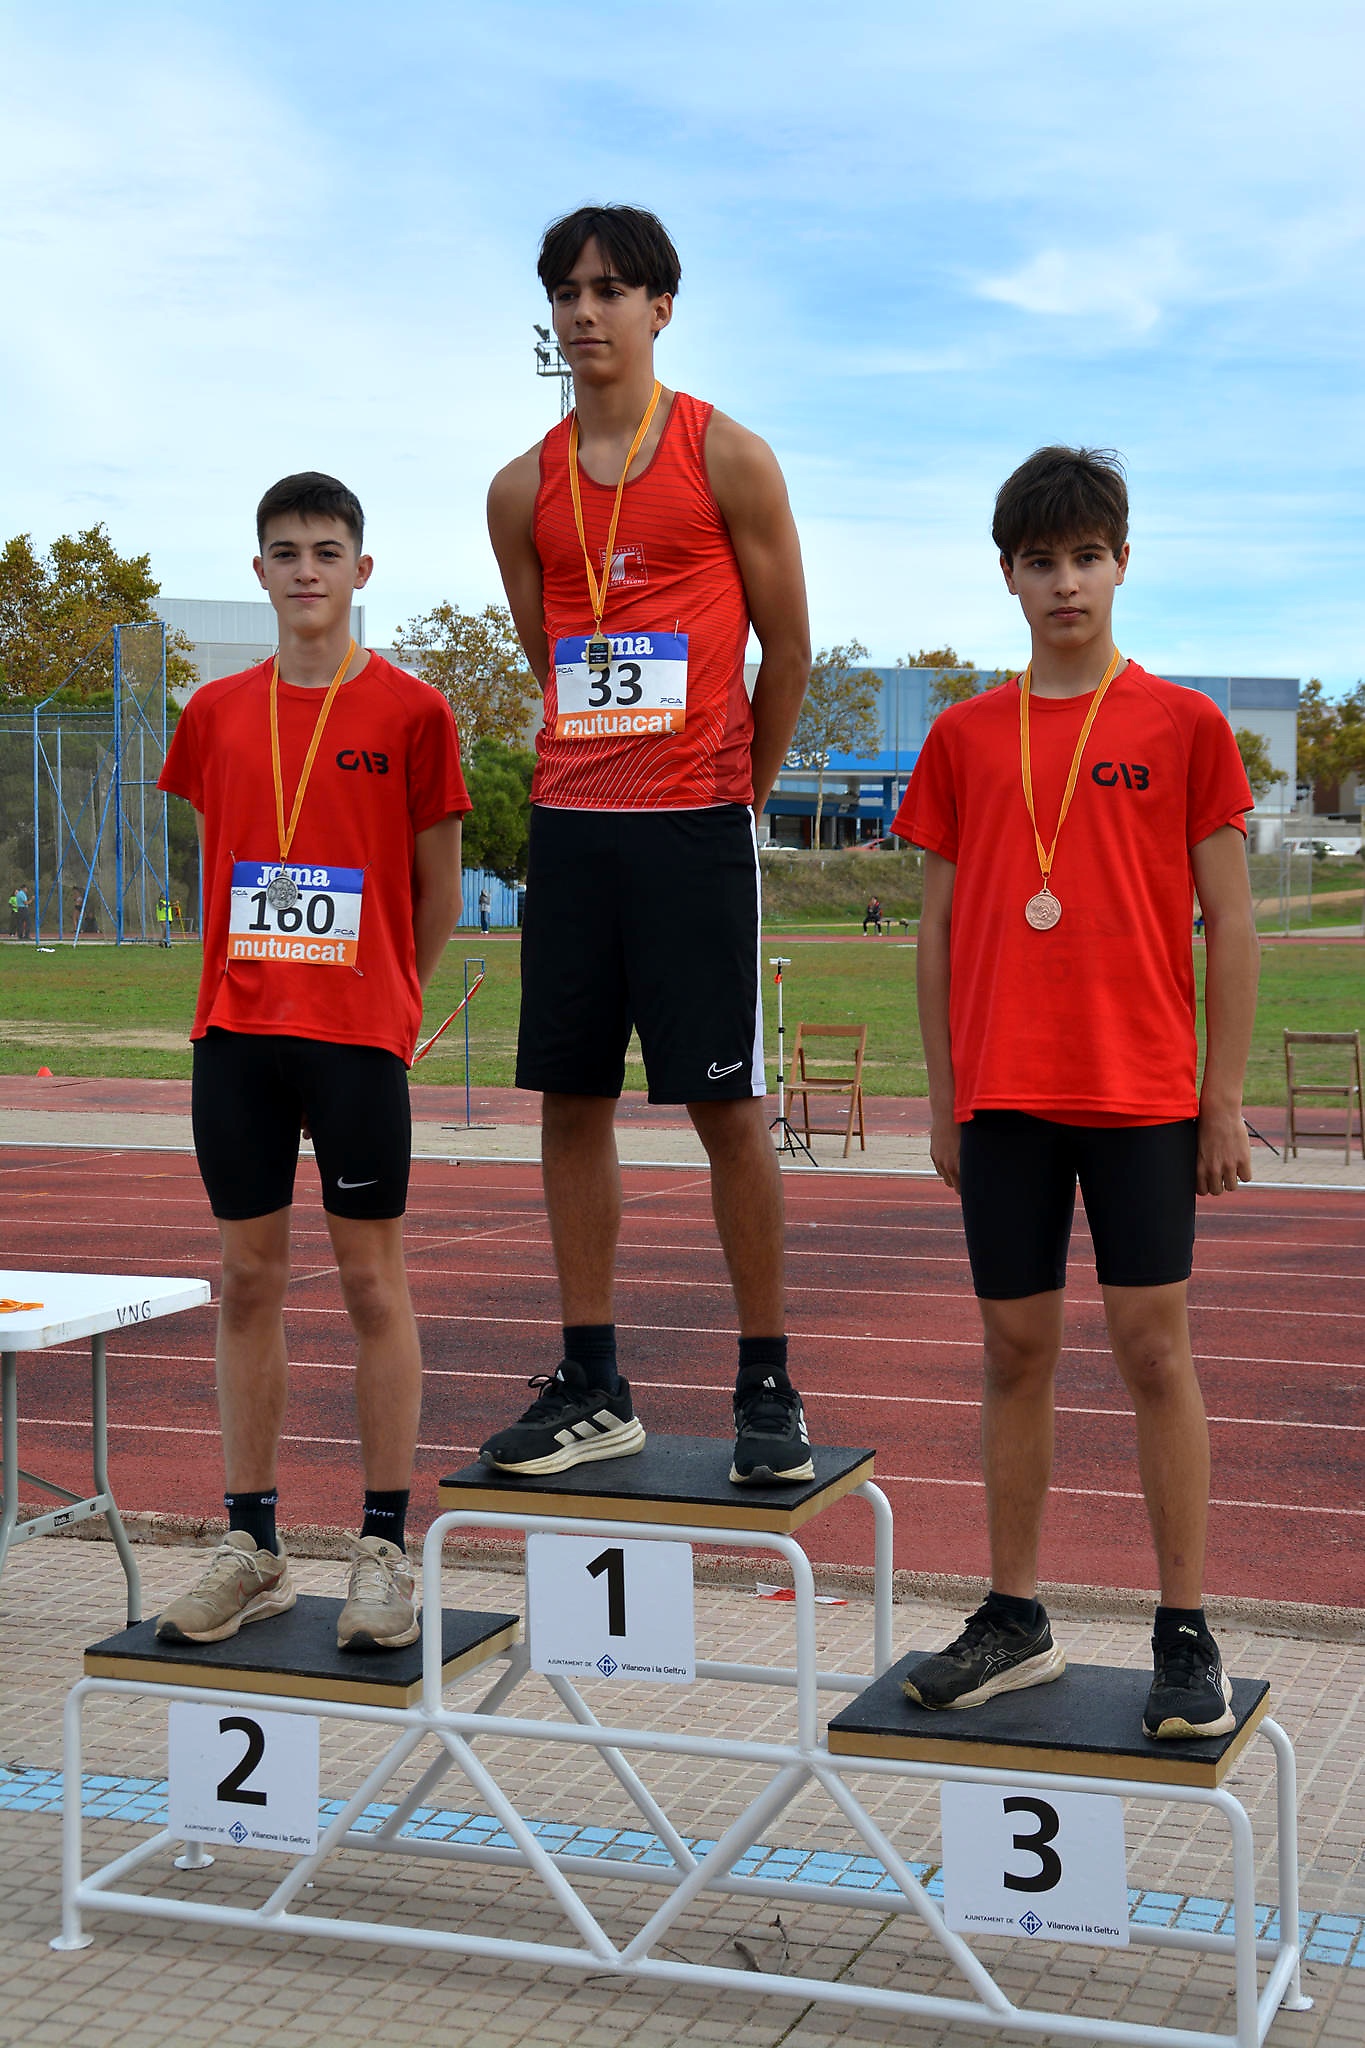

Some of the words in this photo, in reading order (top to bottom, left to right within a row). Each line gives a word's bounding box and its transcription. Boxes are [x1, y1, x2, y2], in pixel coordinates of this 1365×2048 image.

[580, 636, 653, 661] ma
[588, 662, 643, 707] 33
[563, 712, 673, 736] mutuacat
[249, 890, 335, 935] 160
[233, 938, 346, 962] mutuacat
[117, 1300, 151, 1325] VNG
[585, 1547, 627, 1637] 1
[548, 1658, 583, 1667] AJUNTAMENT
[621, 1663, 651, 1673] Vilanova
[655, 1665, 662, 1673] la
[216, 1715, 268, 1807] 2
[251, 1831, 278, 1841] Vilanova
[1002, 1795, 1063, 1893] 3
[964, 1914, 1004, 1923] AJUNTAMENT
[1046, 1921, 1080, 1932] Vilanova
[1084, 1924, 1092, 1933] la
